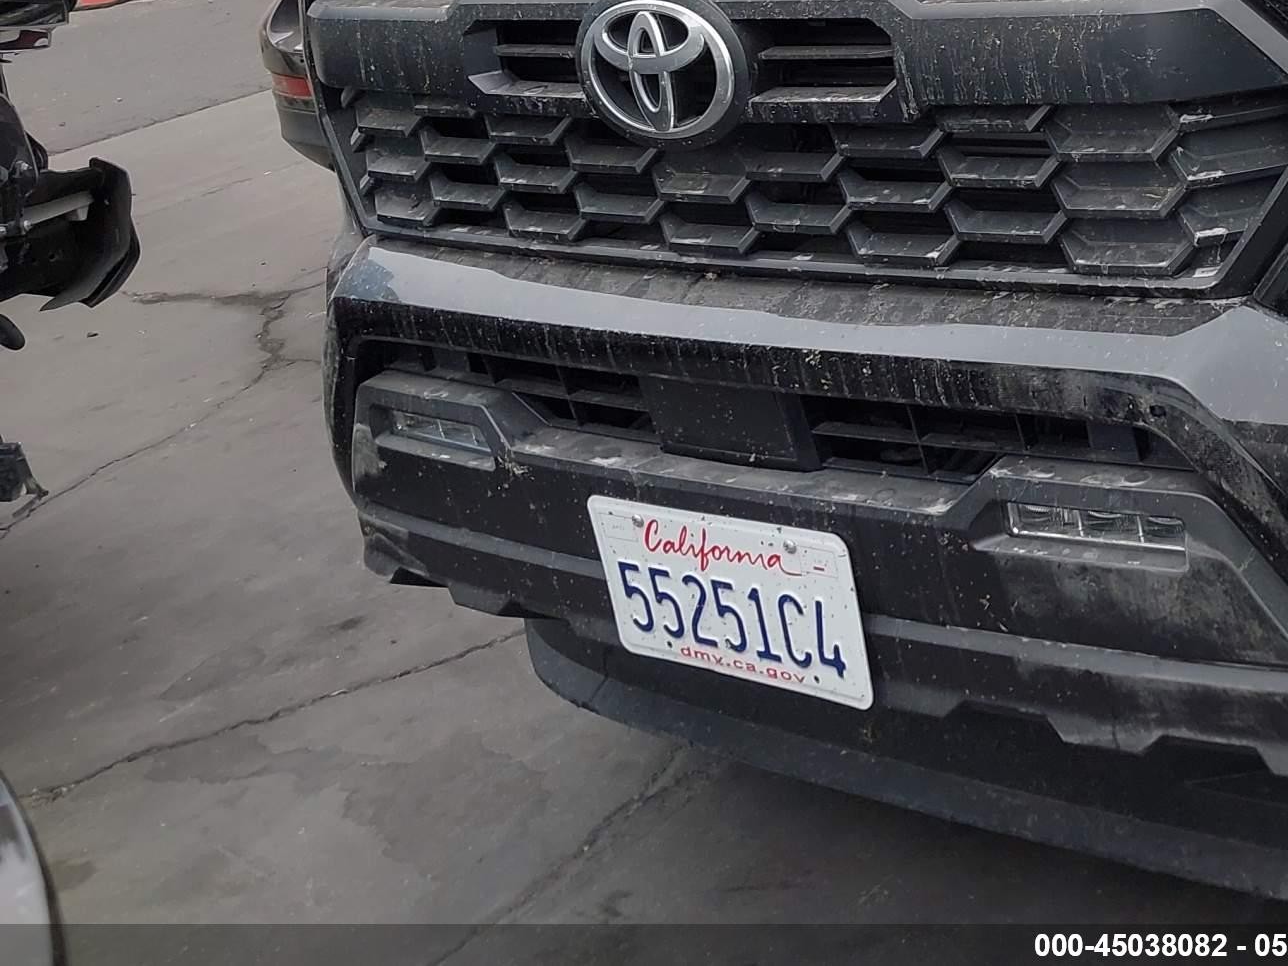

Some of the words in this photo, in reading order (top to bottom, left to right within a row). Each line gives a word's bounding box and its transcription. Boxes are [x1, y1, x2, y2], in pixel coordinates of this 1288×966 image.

[644, 518, 803, 577] California
[617, 560, 847, 680] 55251C4
[680, 645, 806, 685] dmv.ca.gov
